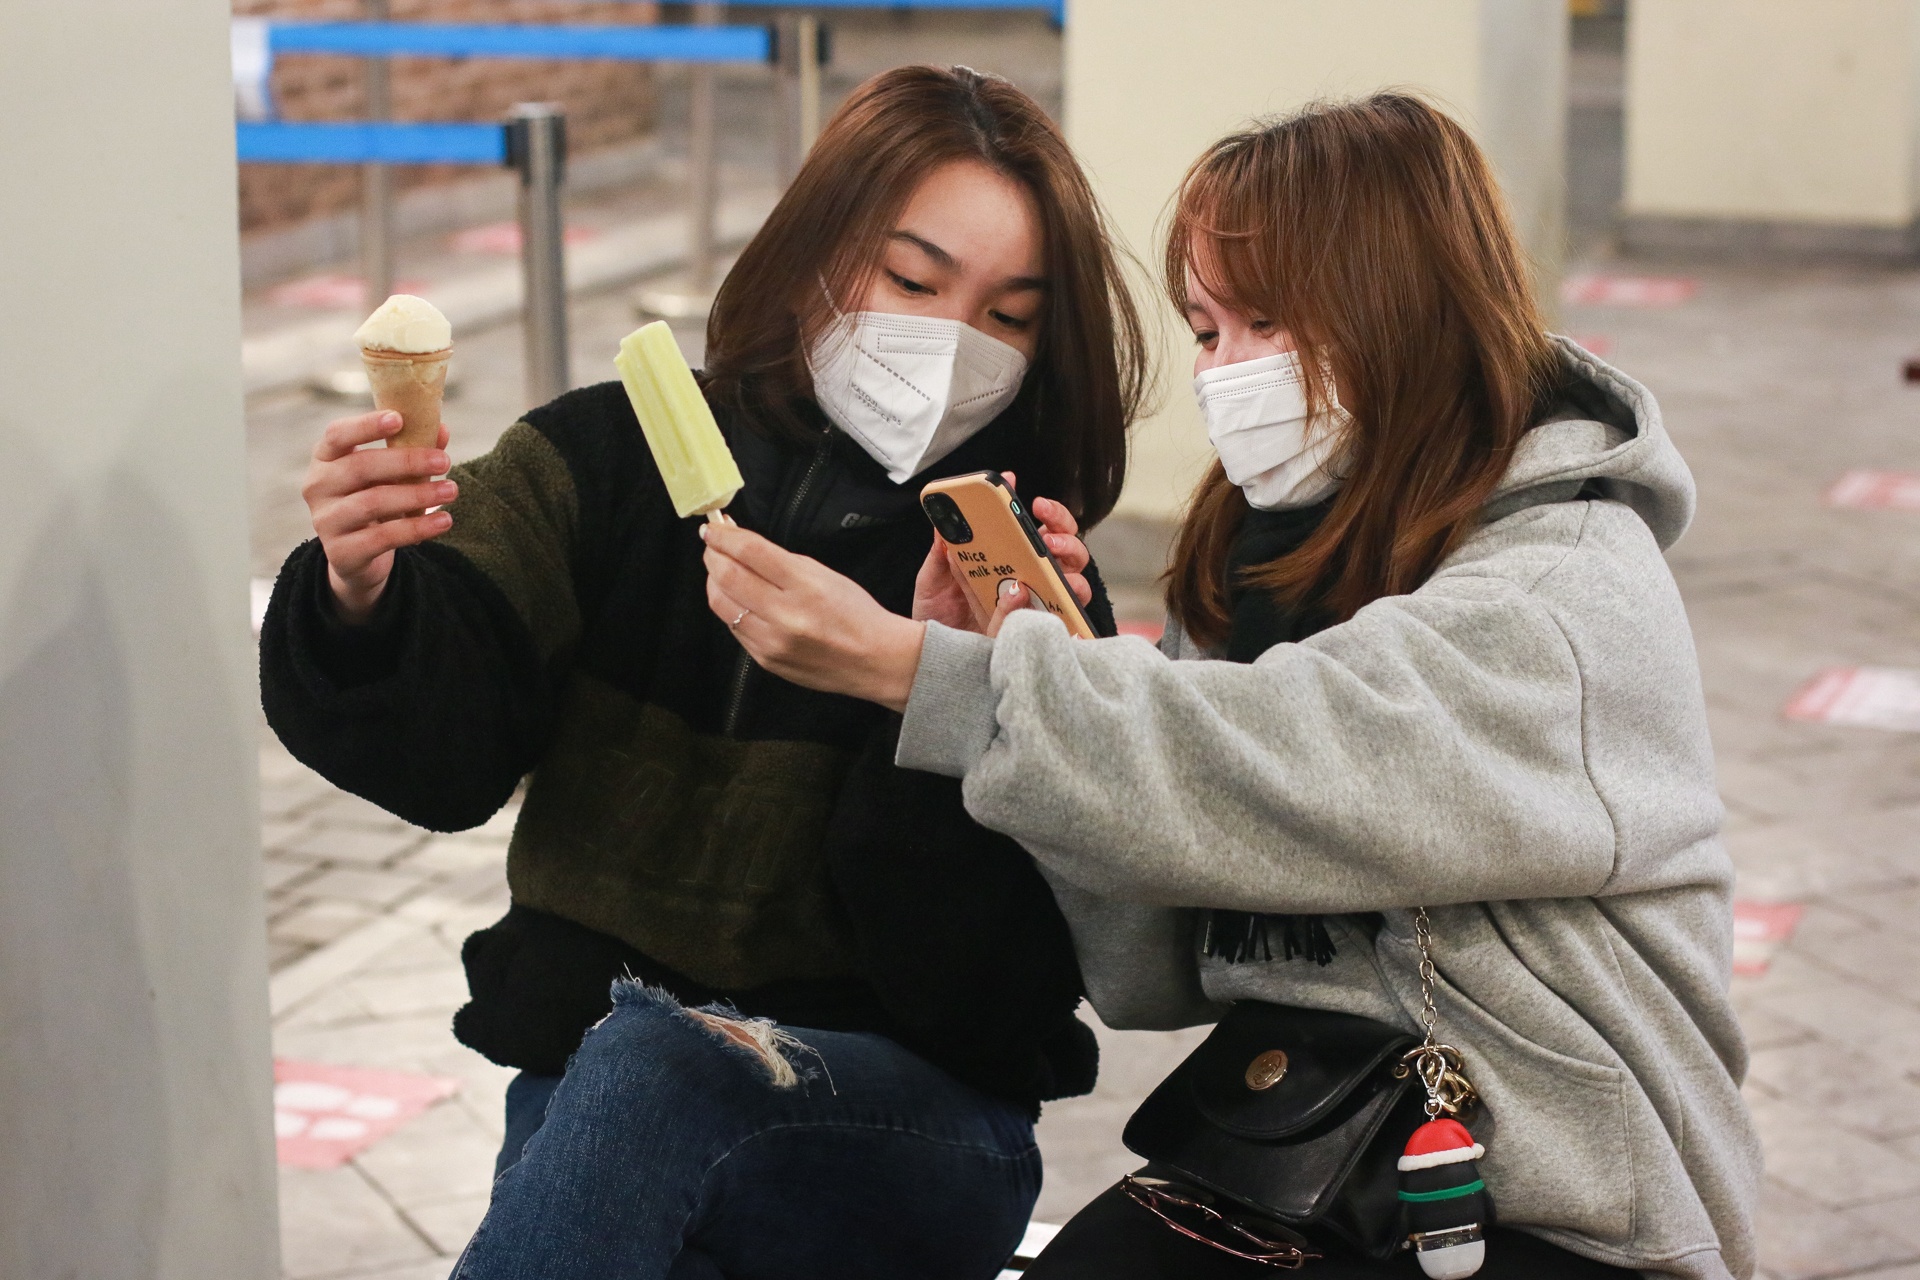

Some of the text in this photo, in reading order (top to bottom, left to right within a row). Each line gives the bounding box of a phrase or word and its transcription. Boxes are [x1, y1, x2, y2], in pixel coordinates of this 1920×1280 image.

[957, 550, 987, 562] Nice
[968, 564, 1016, 578] milk tea
